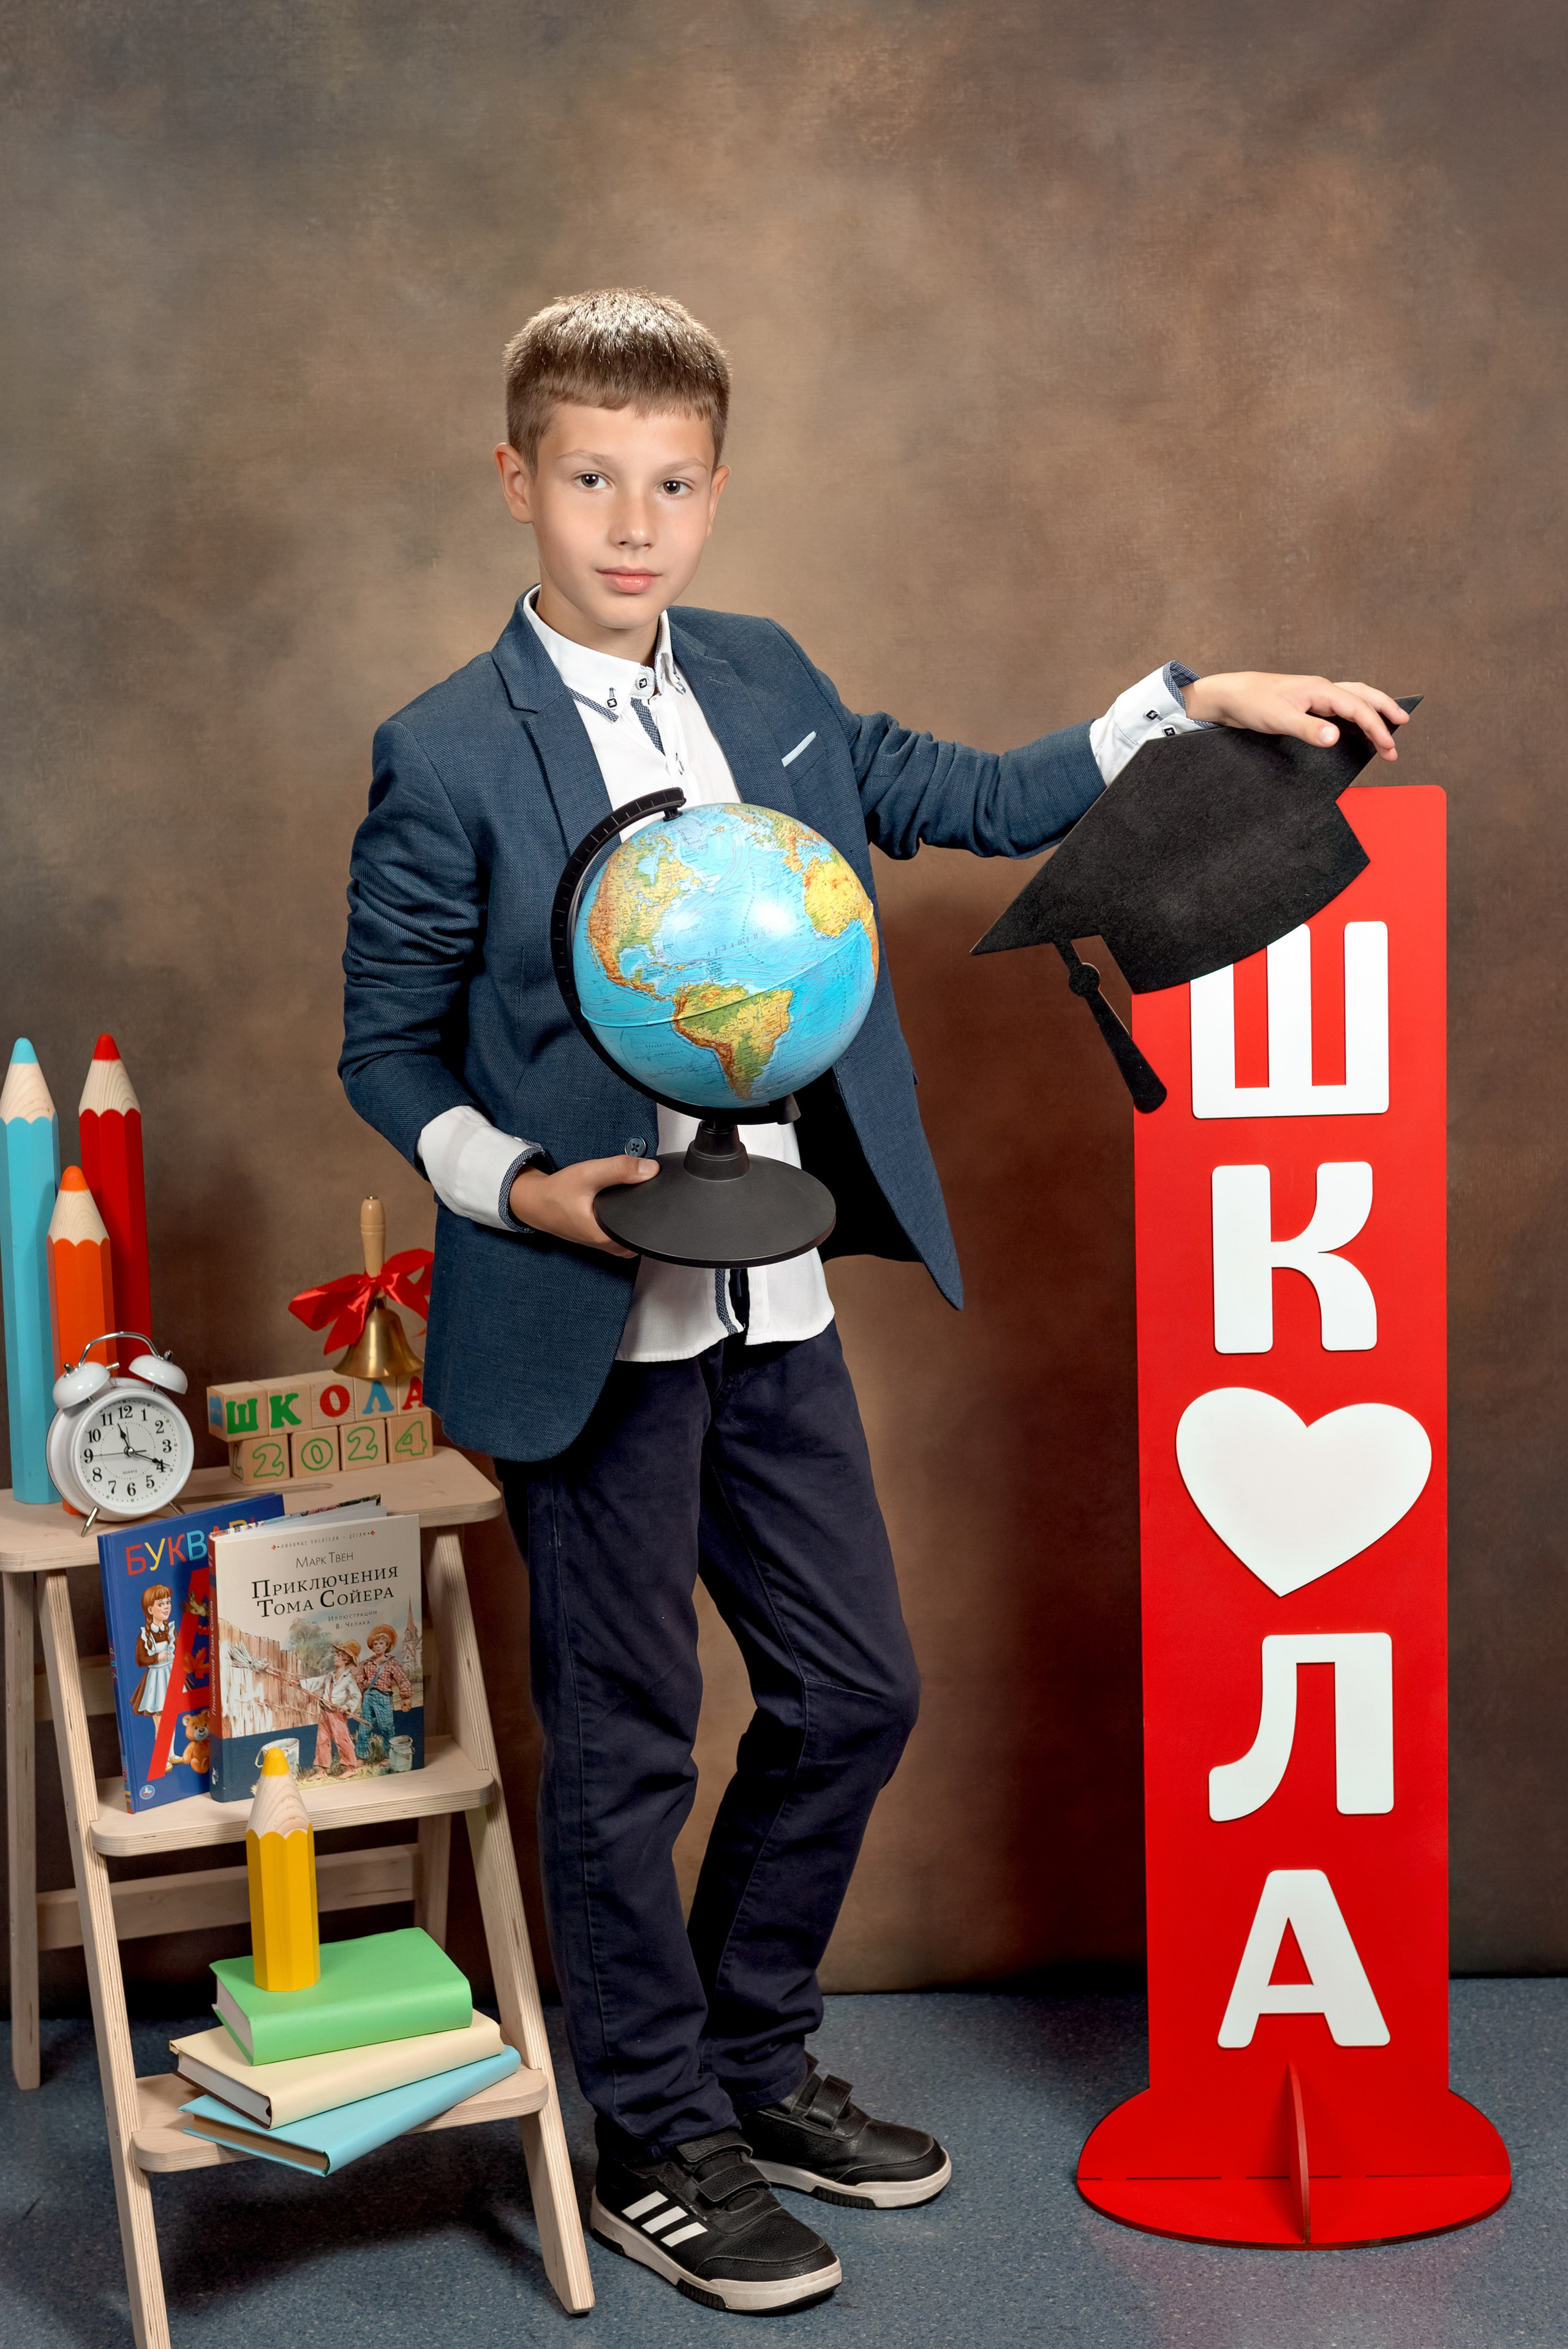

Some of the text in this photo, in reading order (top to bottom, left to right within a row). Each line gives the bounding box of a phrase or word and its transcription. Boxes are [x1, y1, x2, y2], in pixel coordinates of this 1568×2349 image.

[118, 1405, 133, 1419] 12
[225, 1376, 425, 1435] ШКОЛА
[101, 1412, 113, 1426] 11
[141, 1409, 148, 1422] 1
[155, 1420, 164, 1434] 2
[88, 1428, 101, 1443] 10
[162, 1439, 172, 1453] 3
[252, 1420, 427, 1478] 2024
[84, 1449, 94, 1463] 9
[156, 1460, 166, 1473] 4
[92, 1467, 102, 1482] 8
[146, 1474, 155, 1488] 5
[108, 1480, 116, 1494] 7
[127, 1482, 137, 1496] 6
